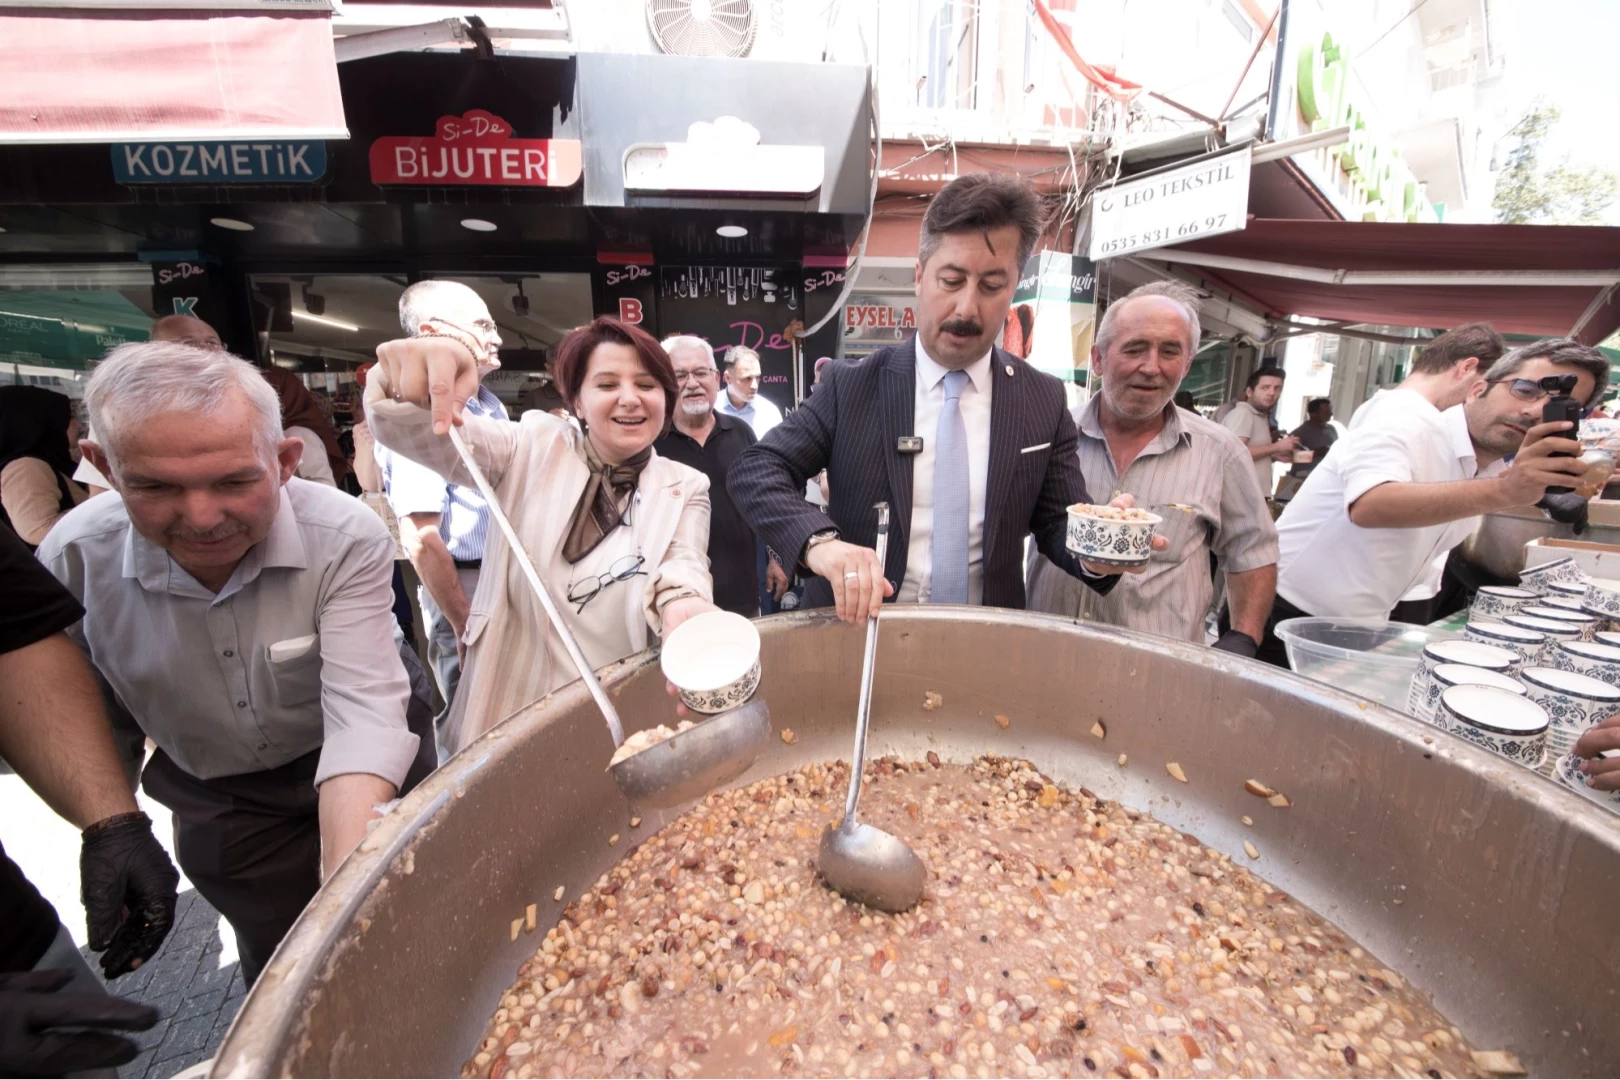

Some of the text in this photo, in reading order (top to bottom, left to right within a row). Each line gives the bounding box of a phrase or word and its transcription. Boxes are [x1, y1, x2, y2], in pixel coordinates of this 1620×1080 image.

[442, 116, 505, 141] Si-De
[1124, 188, 1154, 207] LEO
[1160, 164, 1234, 197] TEKSTİL
[1101, 214, 1227, 253] 0535 831 66 97
[158, 262, 205, 285] Si-De
[606, 264, 652, 285] Si-De
[804, 270, 846, 292] Si-De
